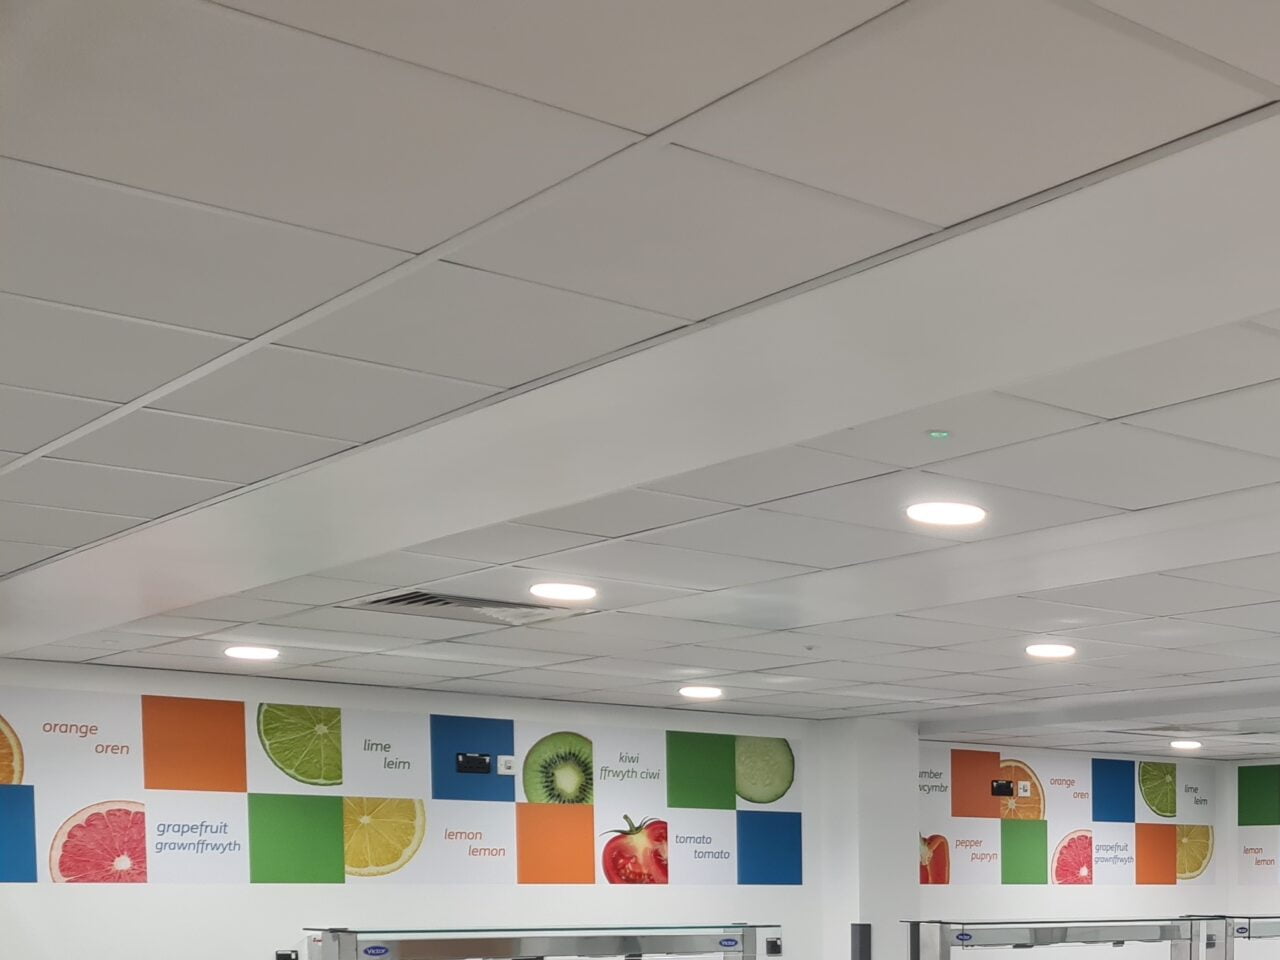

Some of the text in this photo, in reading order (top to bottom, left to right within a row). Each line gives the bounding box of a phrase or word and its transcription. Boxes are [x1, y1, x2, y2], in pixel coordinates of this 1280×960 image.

[42, 719, 98, 739] orange
[94, 741, 130, 755] oren
[363, 738, 391, 754] lime
[383, 756, 411, 770] leim
[618, 751, 640, 764] kiwi
[599, 765, 661, 781] ffrwyth ciwi
[1049, 777, 1076, 788] orange
[1184, 783, 1199, 794] lime
[1072, 790, 1090, 799] oren
[1193, 795, 1208, 806] leim
[156, 820, 229, 837] grapefruit
[443, 827, 483, 841] lemon
[674, 833, 713, 845] tomato
[955, 838, 983, 850] pepper
[155, 838, 241, 854] grawnffrwyth
[467, 844, 506, 857] lemon
[1094, 842, 1129, 855] grapefruit
[1243, 845, 1263, 855] lemon
[693, 849, 731, 860] tomato
[970, 851, 998, 862] pupryn
[1254, 856, 1275, 866] lemon
[366, 946, 387, 954] Victor
